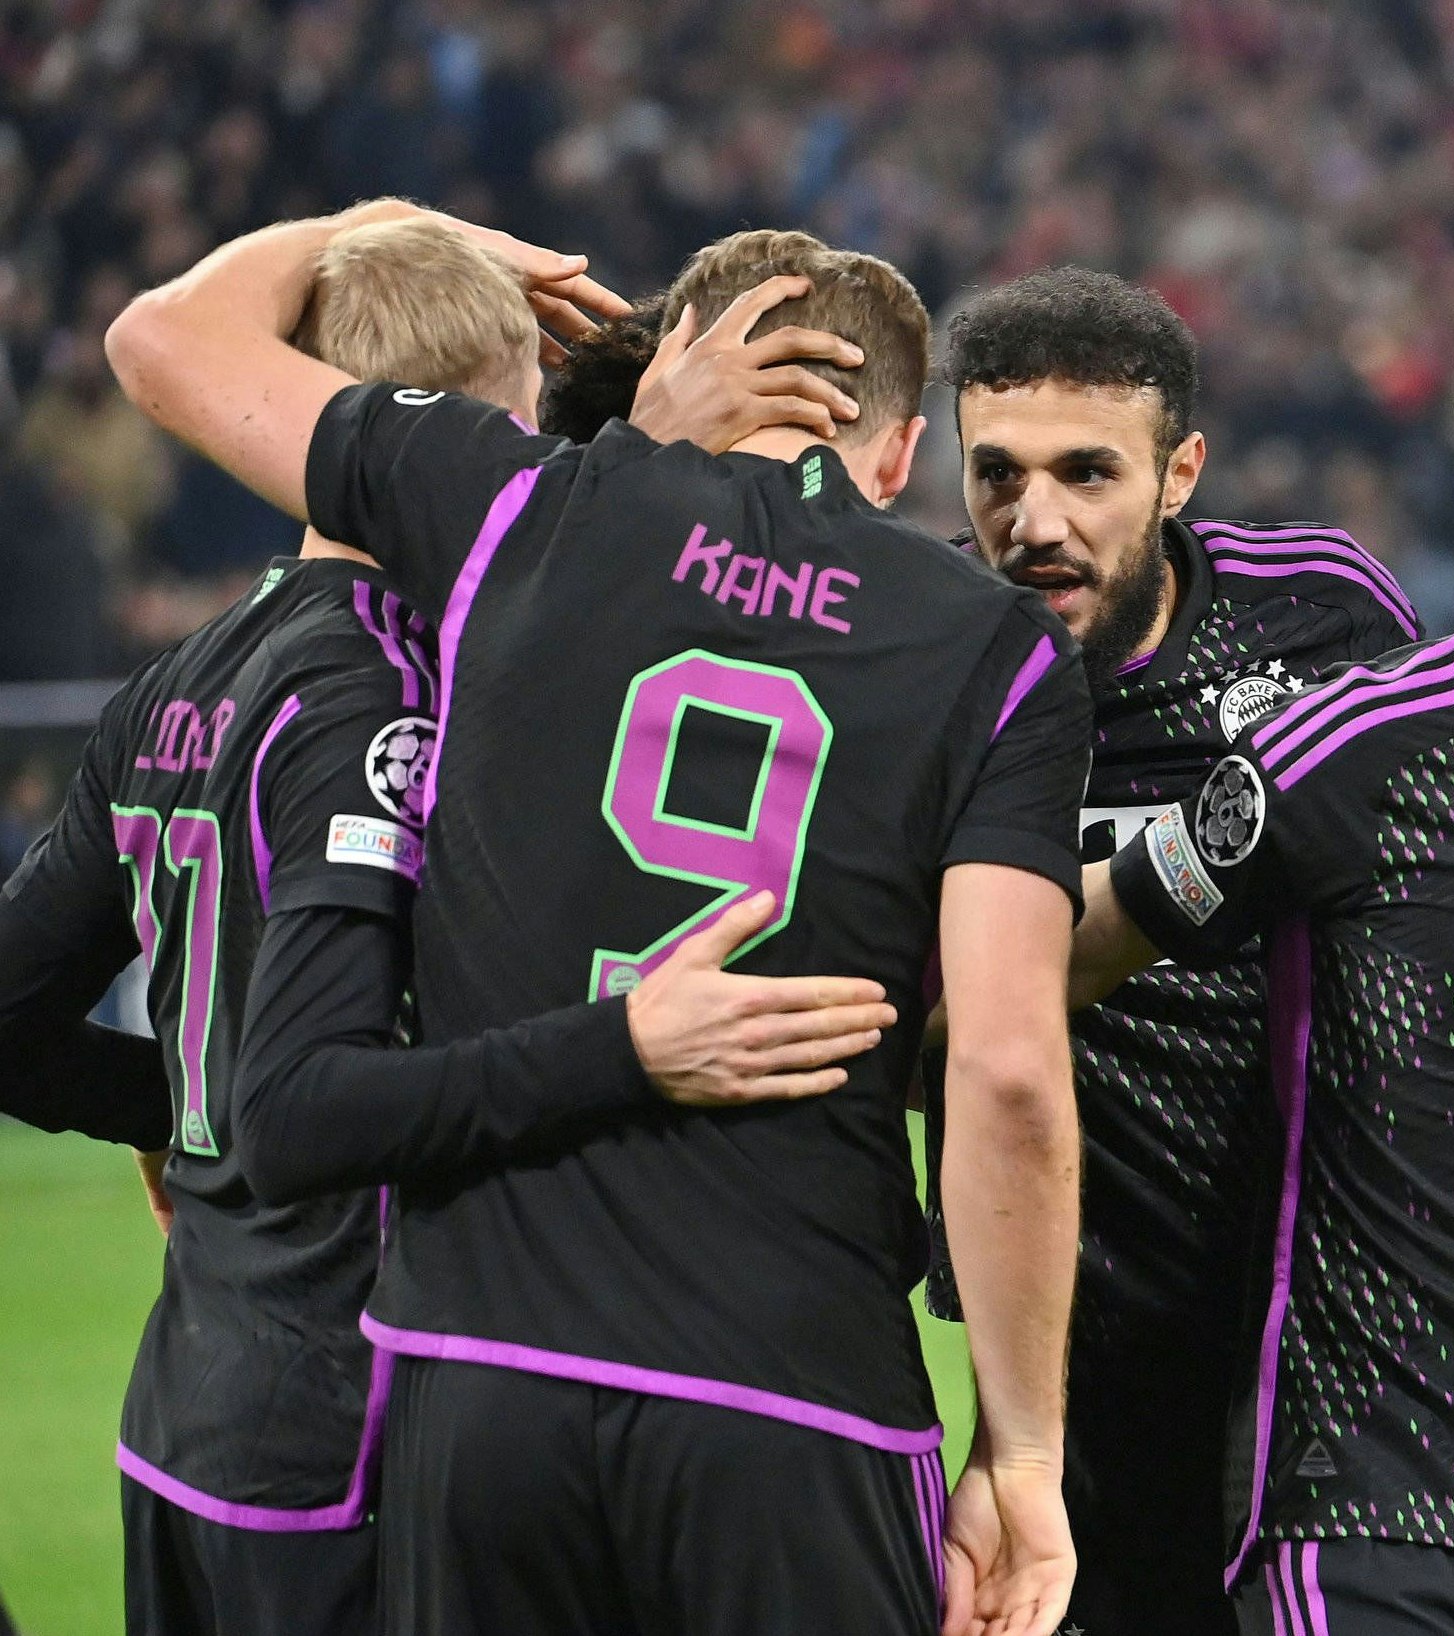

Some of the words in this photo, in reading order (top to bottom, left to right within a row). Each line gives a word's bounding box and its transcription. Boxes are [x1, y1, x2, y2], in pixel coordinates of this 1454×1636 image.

[671, 522, 861, 634] KANE
[1226, 697, 1239, 715] FC
[588, 648, 834, 1004] 9
